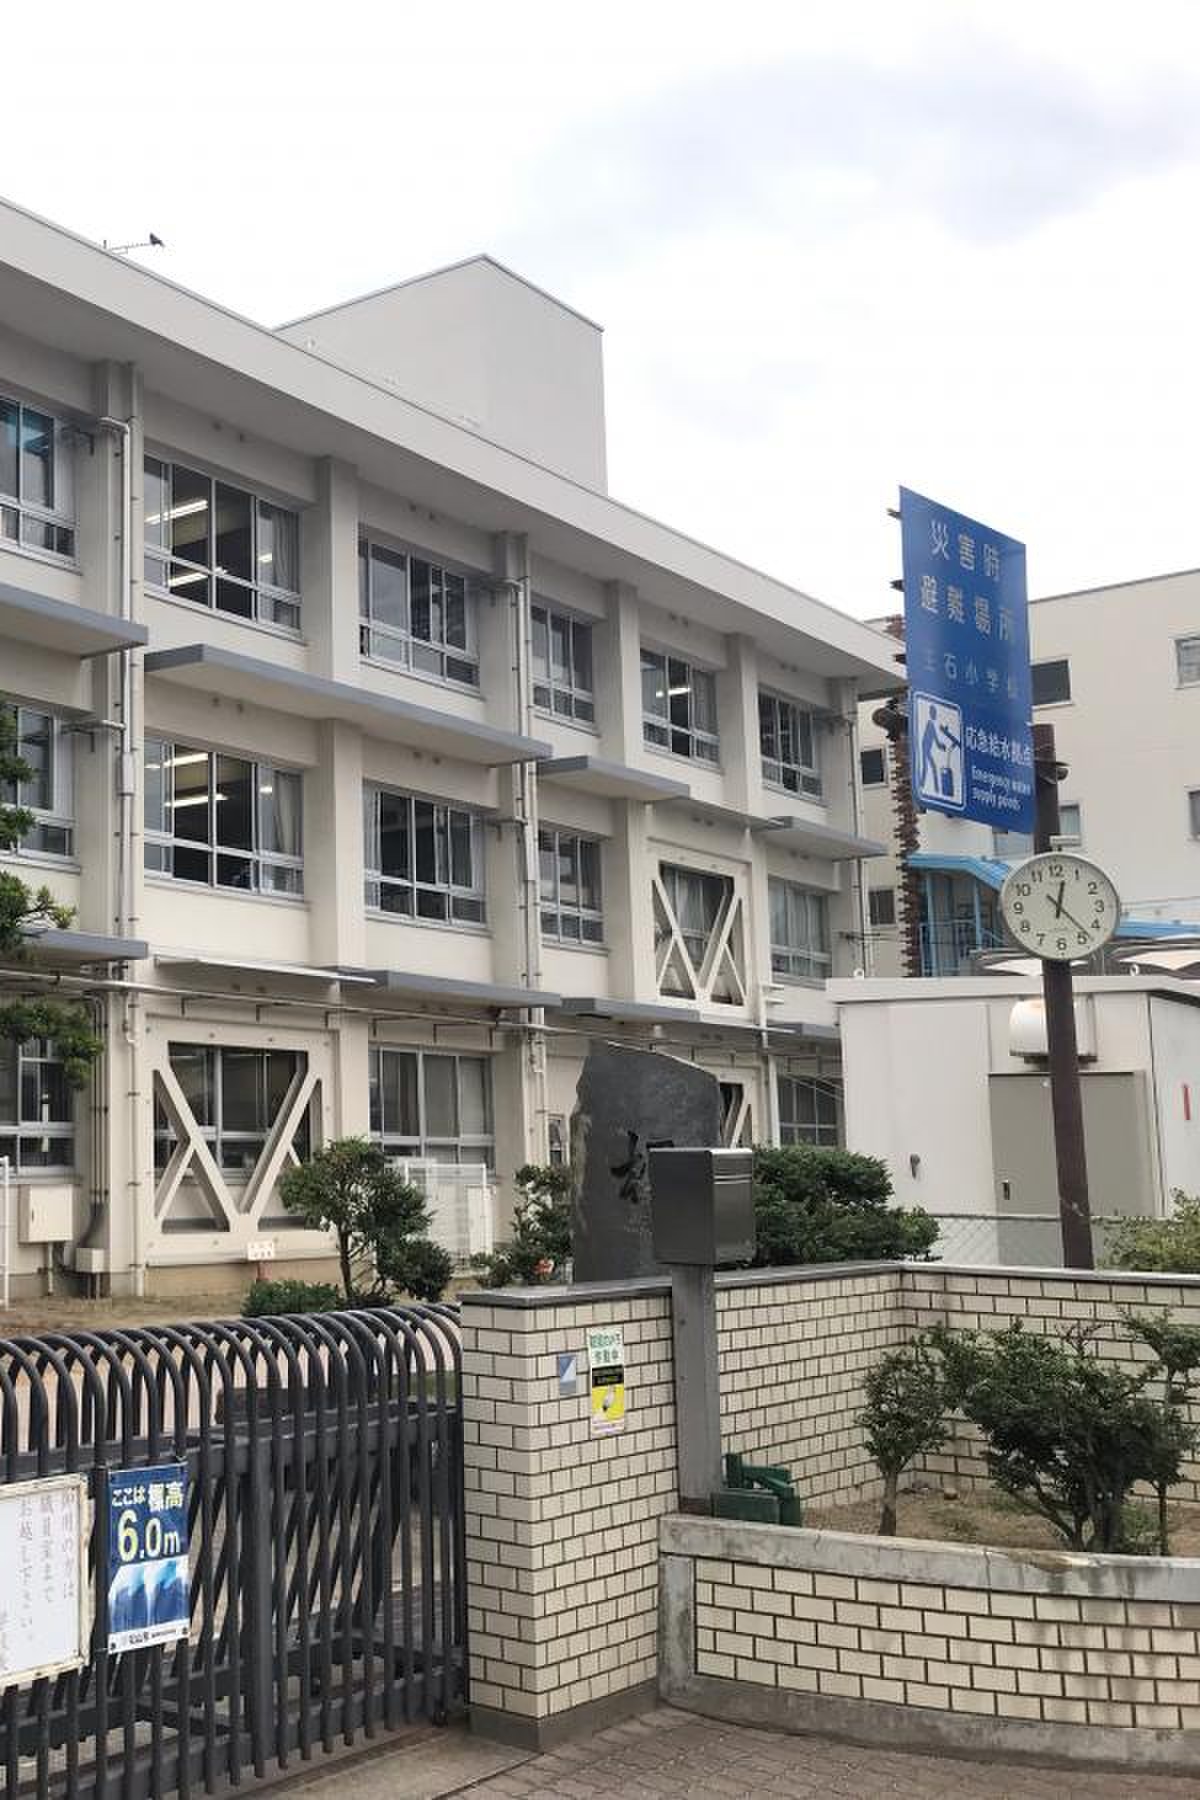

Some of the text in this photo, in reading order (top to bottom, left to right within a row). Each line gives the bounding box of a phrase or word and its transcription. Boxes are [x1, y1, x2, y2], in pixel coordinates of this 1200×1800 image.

[1032, 871, 1043, 881] 11
[1049, 865, 1063, 877] 12
[1016, 884, 1031, 896] 10
[1088, 882, 1098, 895] 2
[1014, 902, 1023, 914] 9
[1095, 900, 1104, 912] 3
[1020, 920, 1031, 932] 8
[1091, 919, 1100, 929] 4
[1036, 933, 1045, 945] 7
[1077, 932, 1087, 944] 5
[1057, 938, 1067, 951] 6
[118, 1509, 180, 1562] 6.0m
